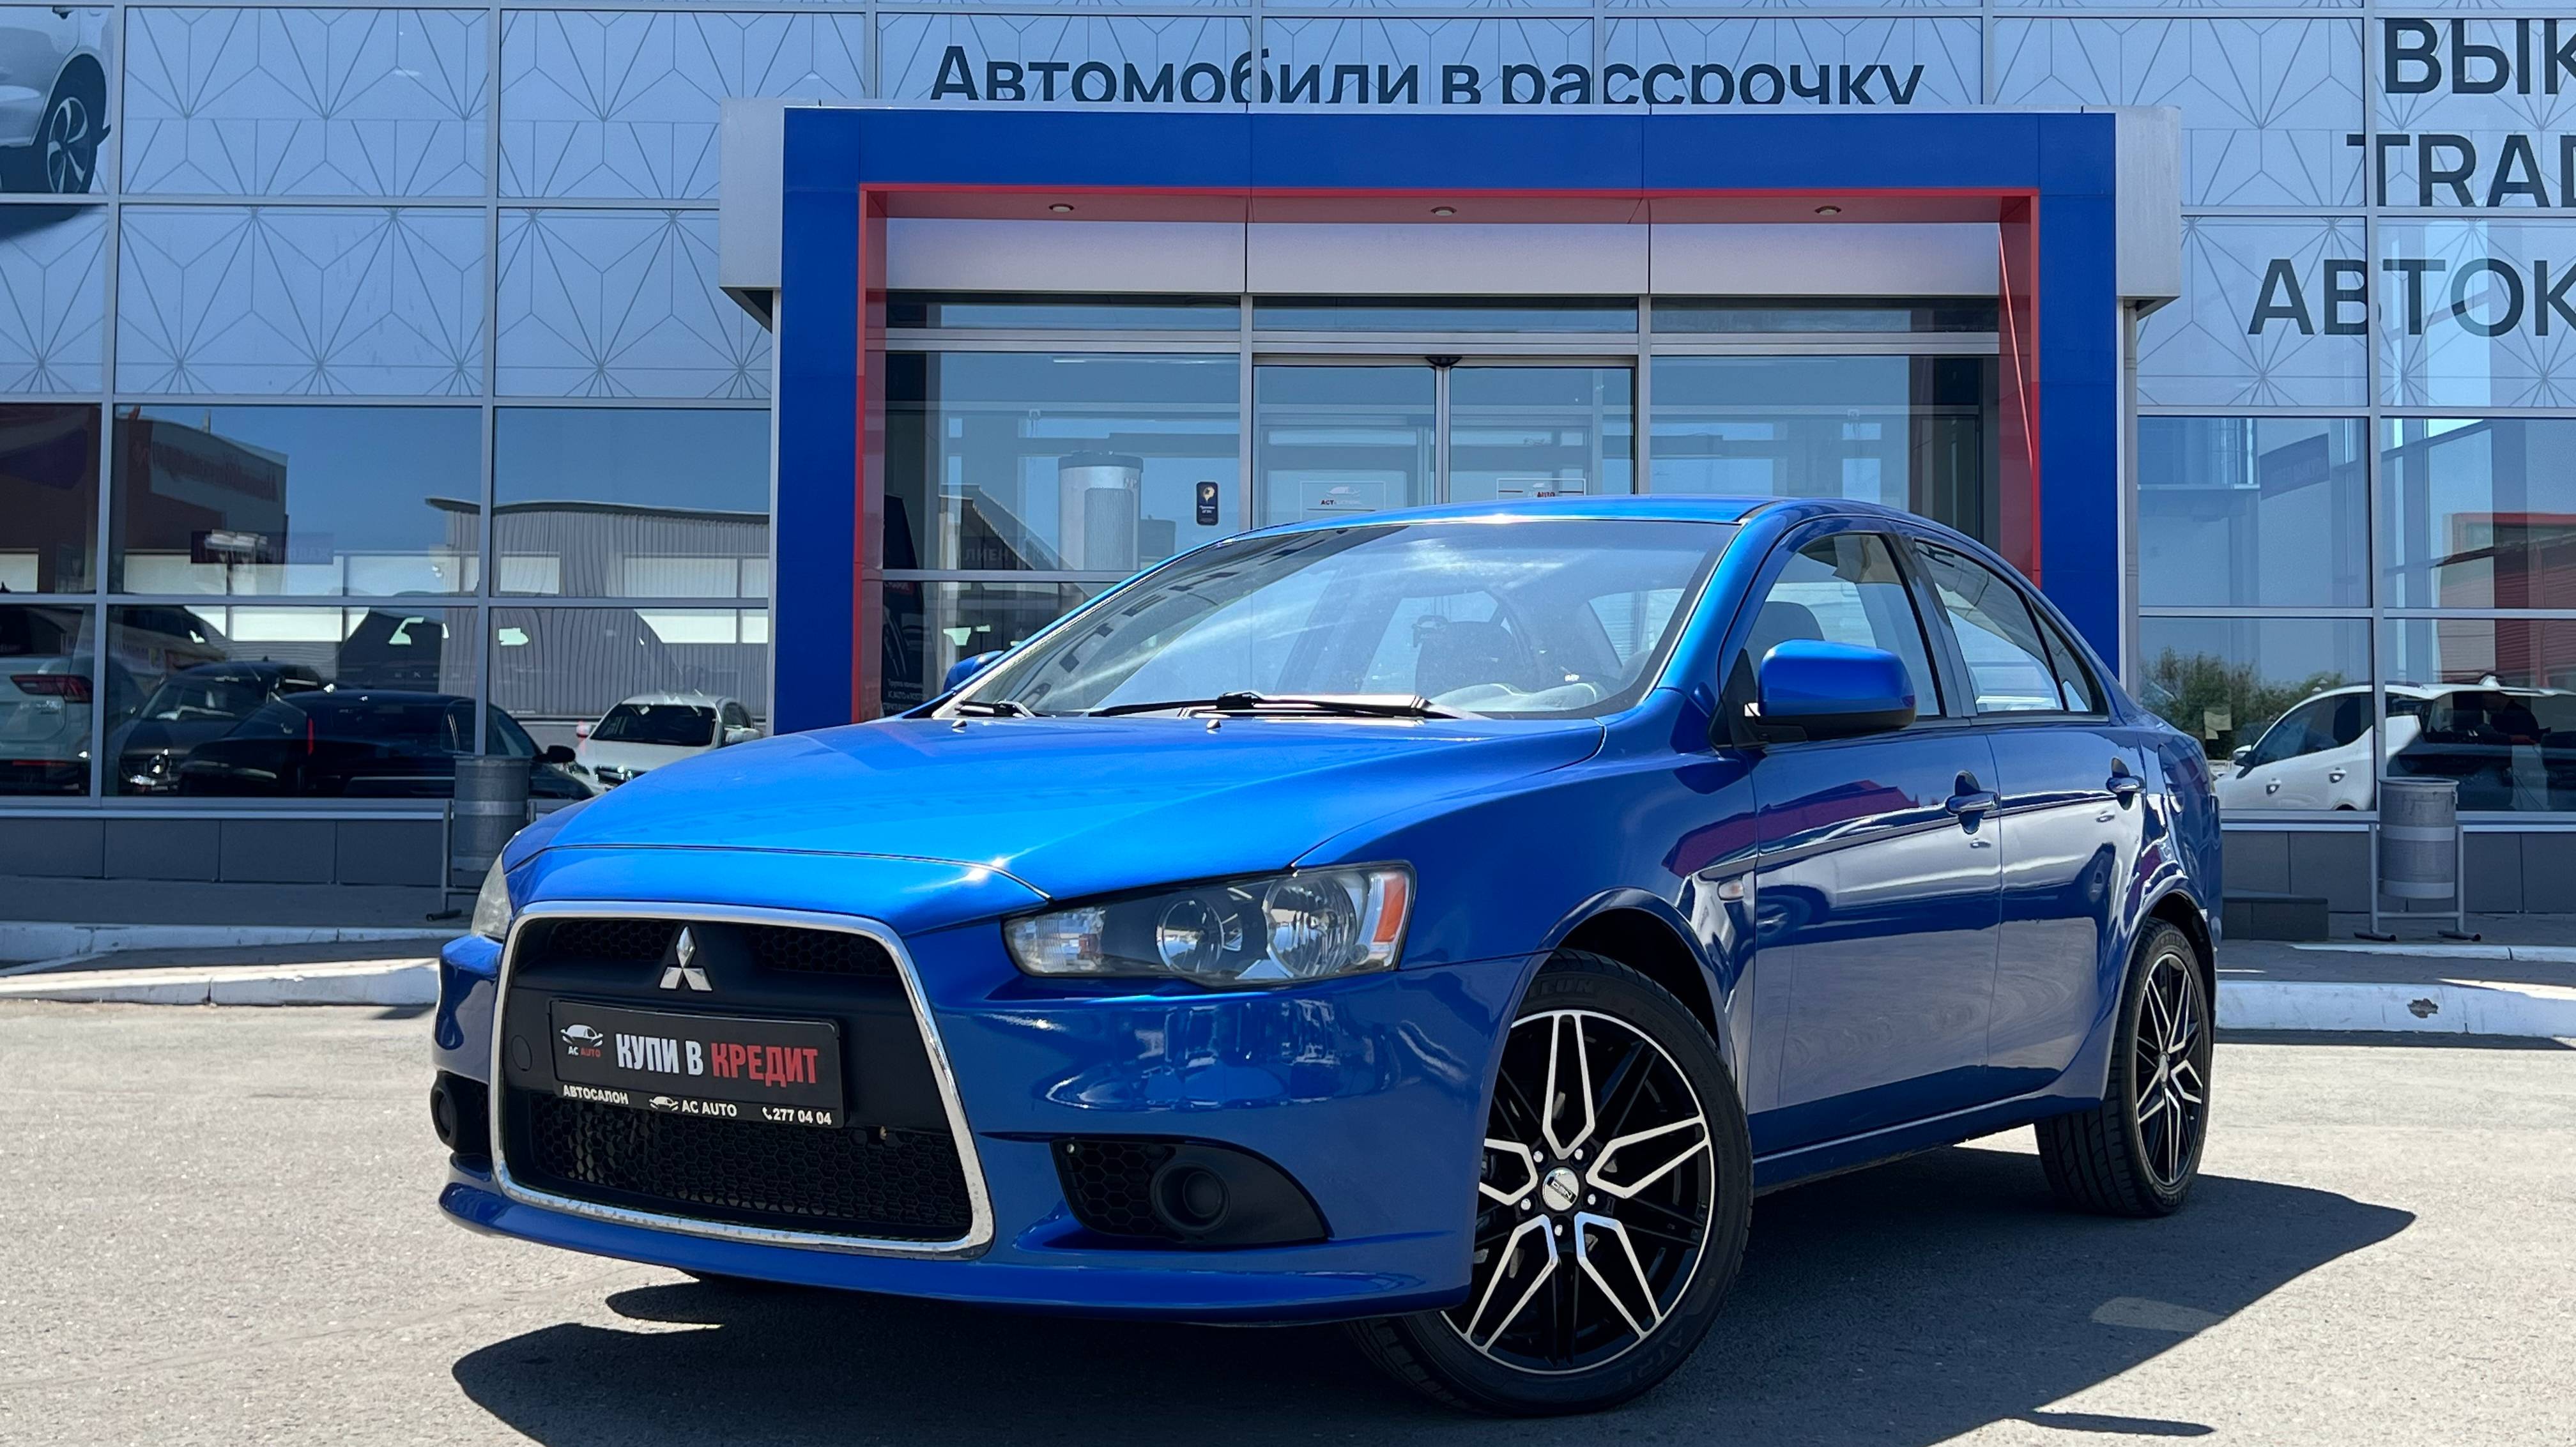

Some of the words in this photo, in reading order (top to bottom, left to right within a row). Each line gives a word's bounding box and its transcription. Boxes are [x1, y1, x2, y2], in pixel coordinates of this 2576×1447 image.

[930, 45, 1418, 104] Автомобили
[1442, 65, 1481, 104] в
[1502, 64, 1924, 105] рассрочку
[568, 1046, 579, 1056] AC
[581, 1047, 601, 1058] AUTO
[615, 1033, 680, 1074] КУПИ
[685, 1040, 704, 1076] В
[710, 1043, 818, 1088] КРЕДИТ
[563, 1084, 629, 1105] АВТОСАЛОН
[682, 1099, 699, 1114] AC
[702, 1101, 737, 1117] AUTO
[772, 1108, 794, 1122] 277
[797, 1110, 813, 1124] 04
[816, 1112, 832, 1126] 04
